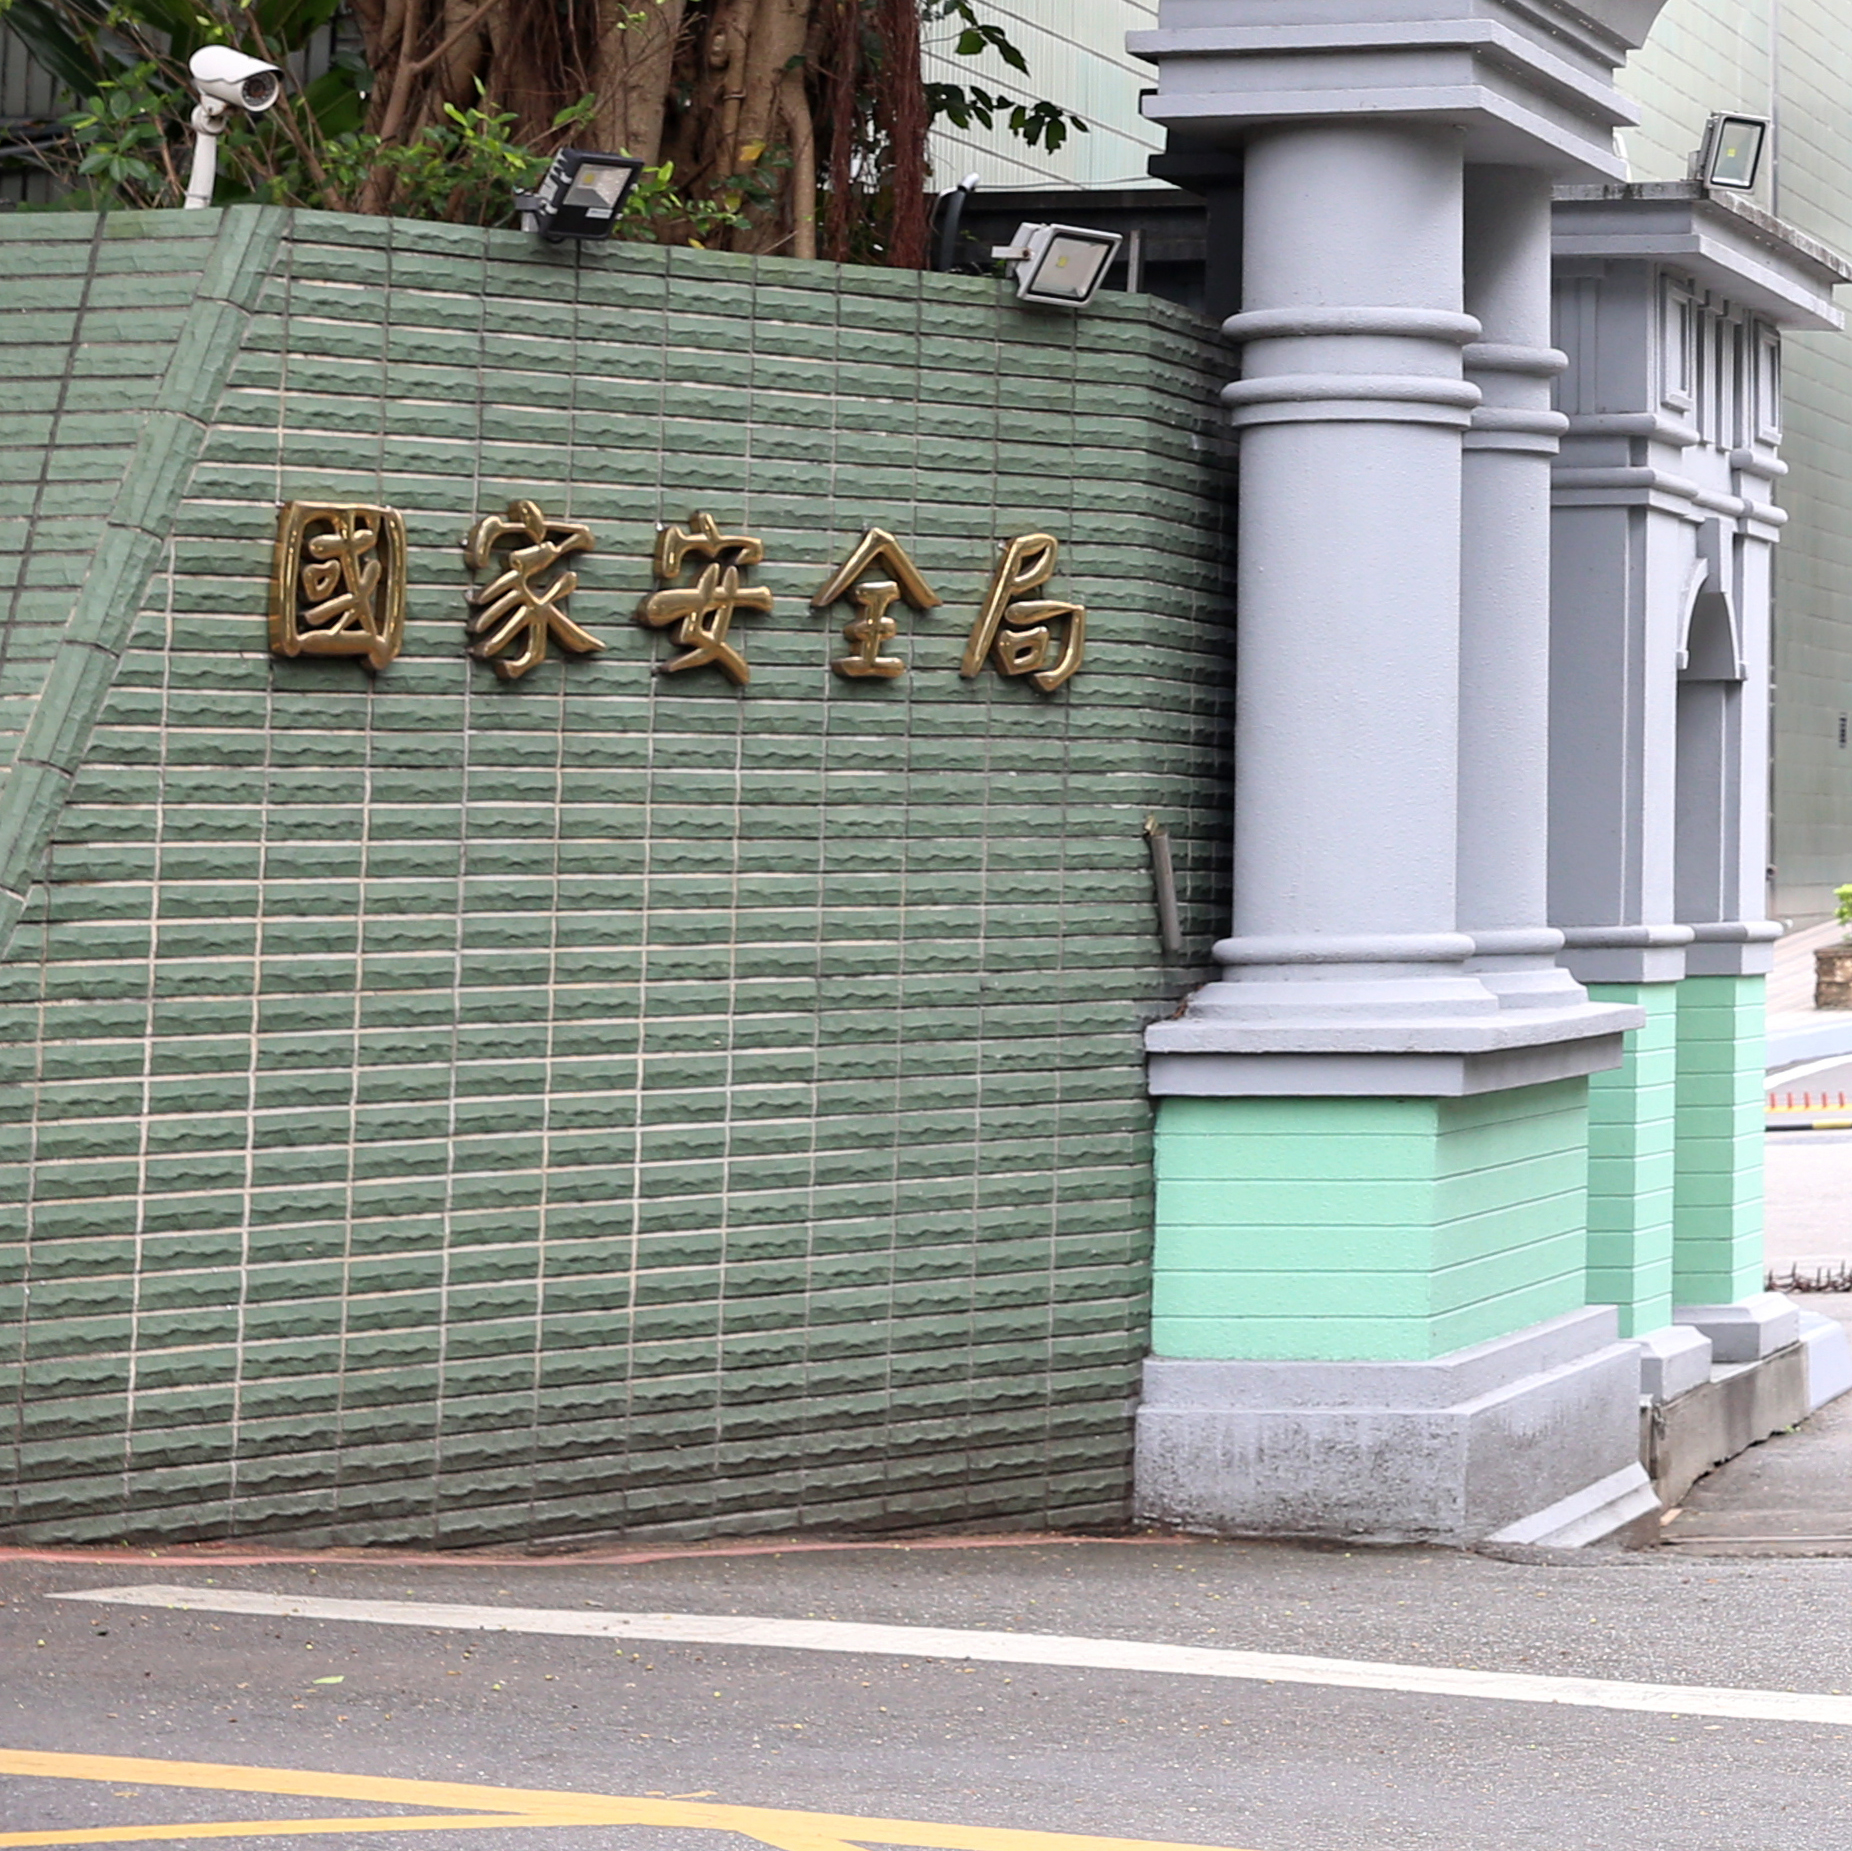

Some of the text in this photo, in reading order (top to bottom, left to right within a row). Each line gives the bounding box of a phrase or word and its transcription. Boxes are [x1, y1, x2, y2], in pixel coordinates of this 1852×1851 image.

[268, 499, 1086, 692] 國家安全局
